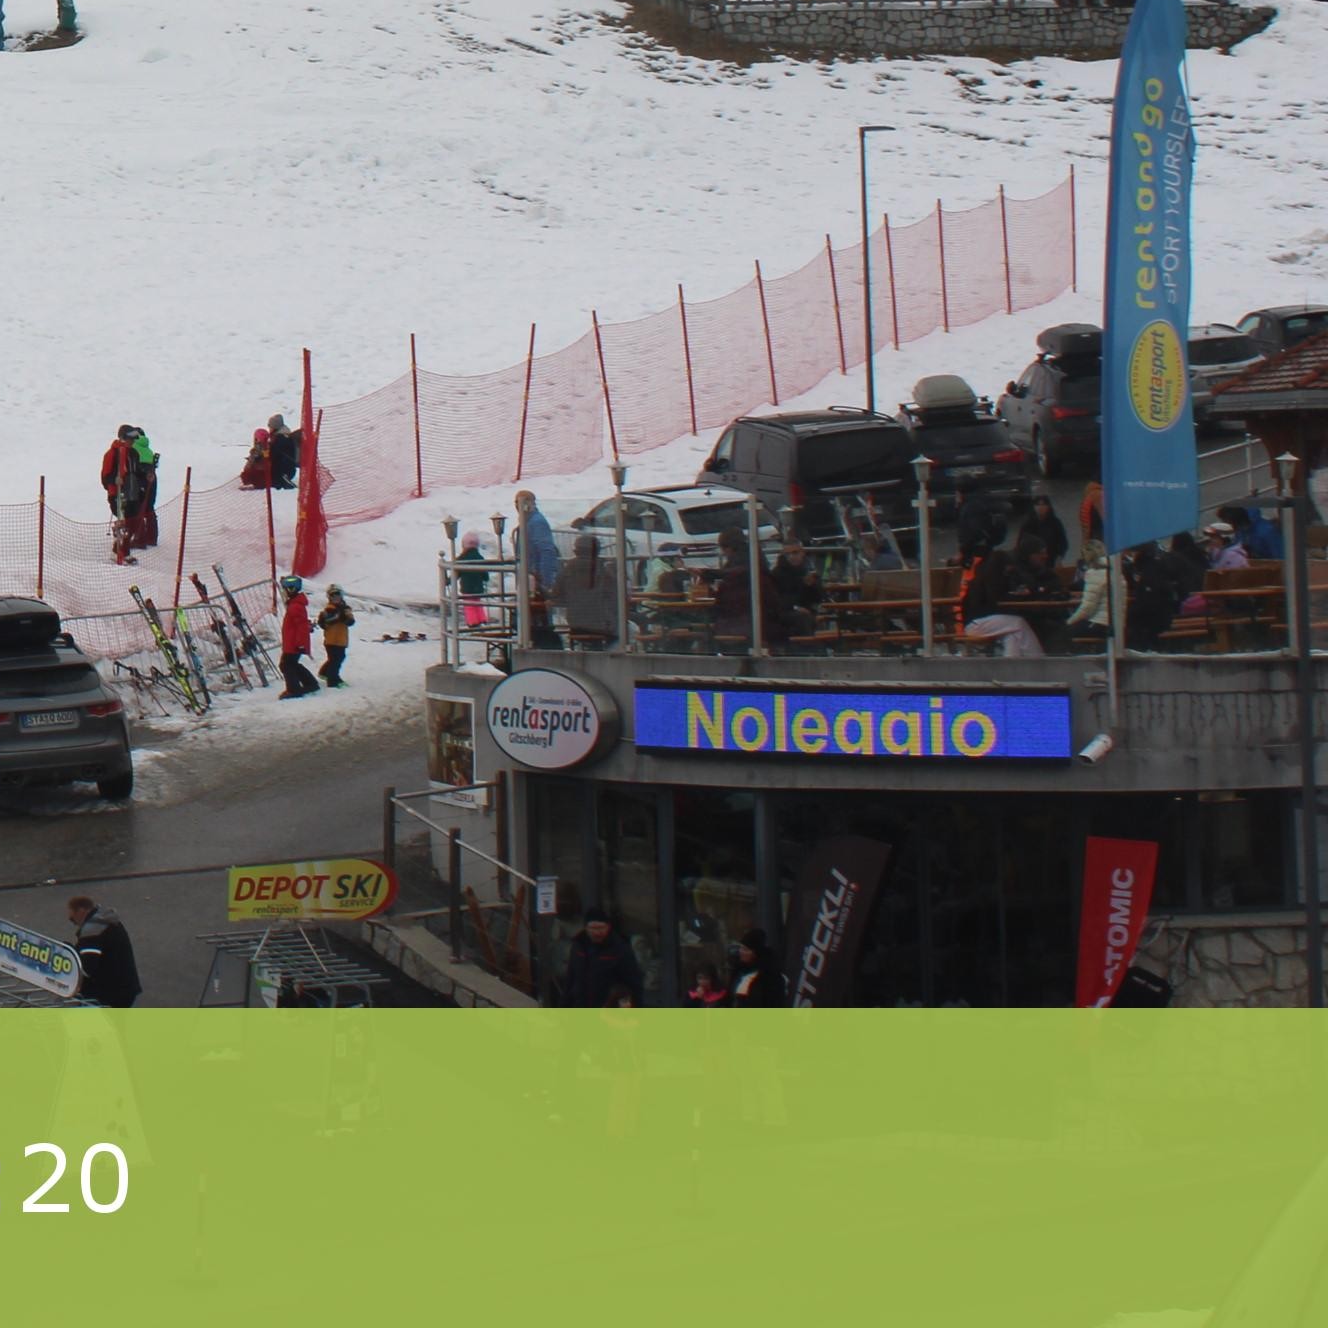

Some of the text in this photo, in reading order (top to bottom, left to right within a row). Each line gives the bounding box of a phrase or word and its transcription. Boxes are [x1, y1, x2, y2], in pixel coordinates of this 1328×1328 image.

[1132, 77, 1165, 310] rent and go
[1149, 329, 1167, 423] rentasport
[492, 695, 592, 747] rentasport
[508, 732, 548, 748] Gitschberg
[233, 873, 384, 902] DEPOT SKI
[340, 898, 375, 908] SERVICE
[19, 940, 51, 965] and
[51, 954, 73, 974] go
[792, 867, 850, 1008] STÖCKLI
